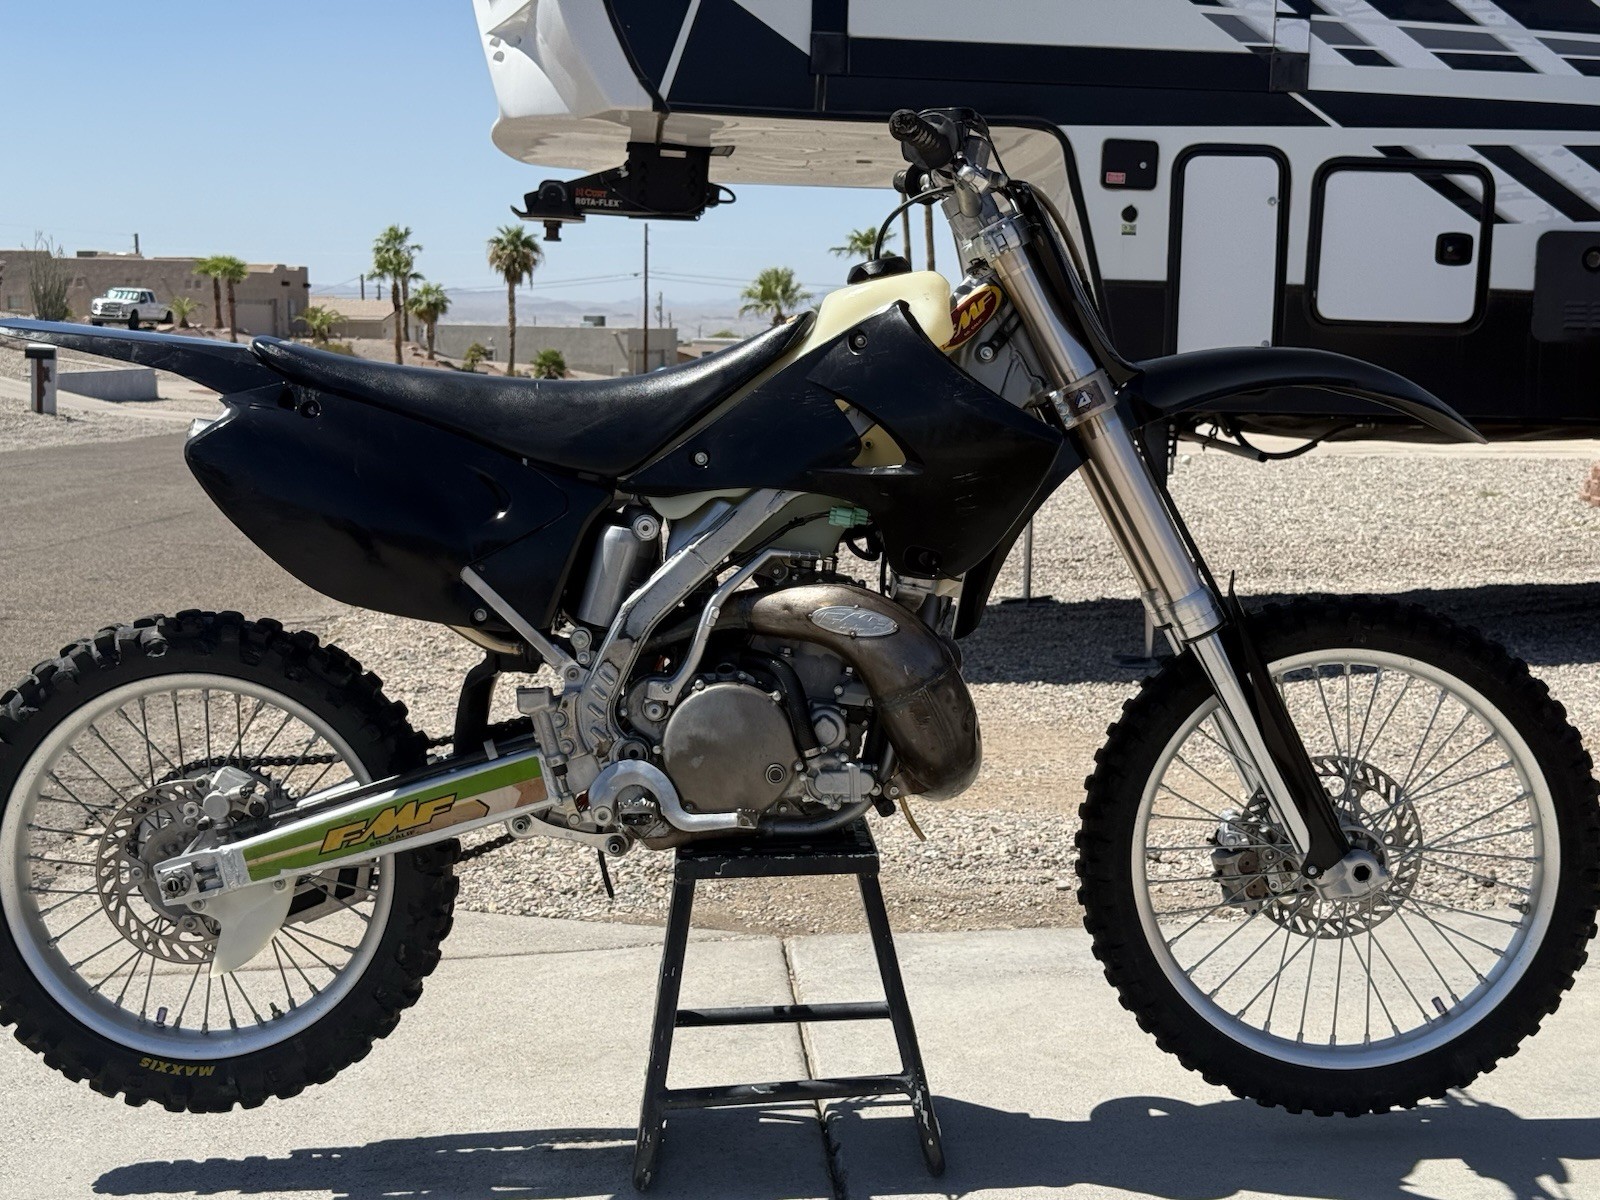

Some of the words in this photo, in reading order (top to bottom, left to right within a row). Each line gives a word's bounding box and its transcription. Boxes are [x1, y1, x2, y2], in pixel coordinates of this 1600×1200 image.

[953, 290, 993, 339] MF
[318, 792, 457, 855] FMF
[139, 1057, 216, 1077] MAXXIS
